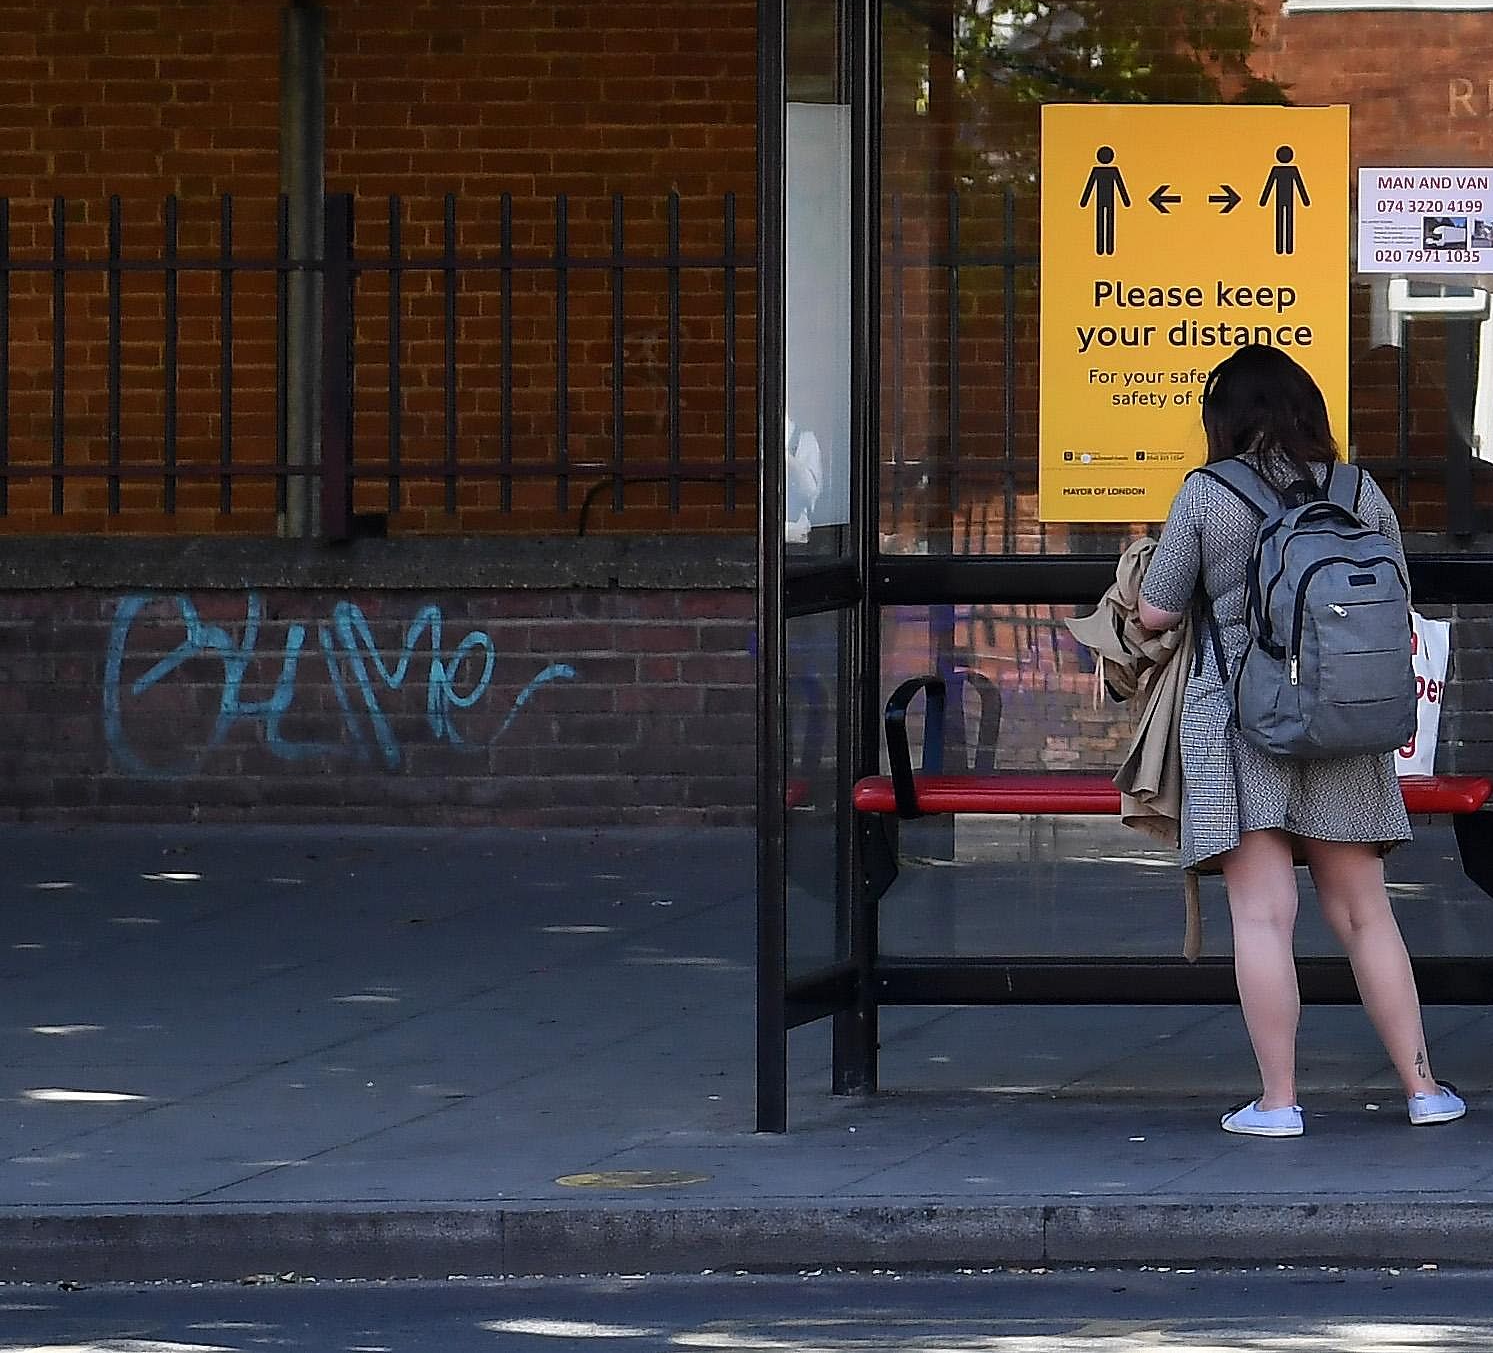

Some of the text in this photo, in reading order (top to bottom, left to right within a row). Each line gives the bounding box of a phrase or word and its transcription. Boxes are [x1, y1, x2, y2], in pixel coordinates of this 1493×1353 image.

[1379, 177, 1487, 189] MAN AND VAN
[1378, 201, 1482, 212] 074 3220 4199
[1376, 250, 1480, 262] 020 7971 1035
[1095, 281, 1295, 313] Please keep
[1077, 321, 1313, 353] your distance
[1090, 368, 1212, 387] For your safe
[1112, 391, 1167, 408] safety
[1174, 391, 1192, 405] of
